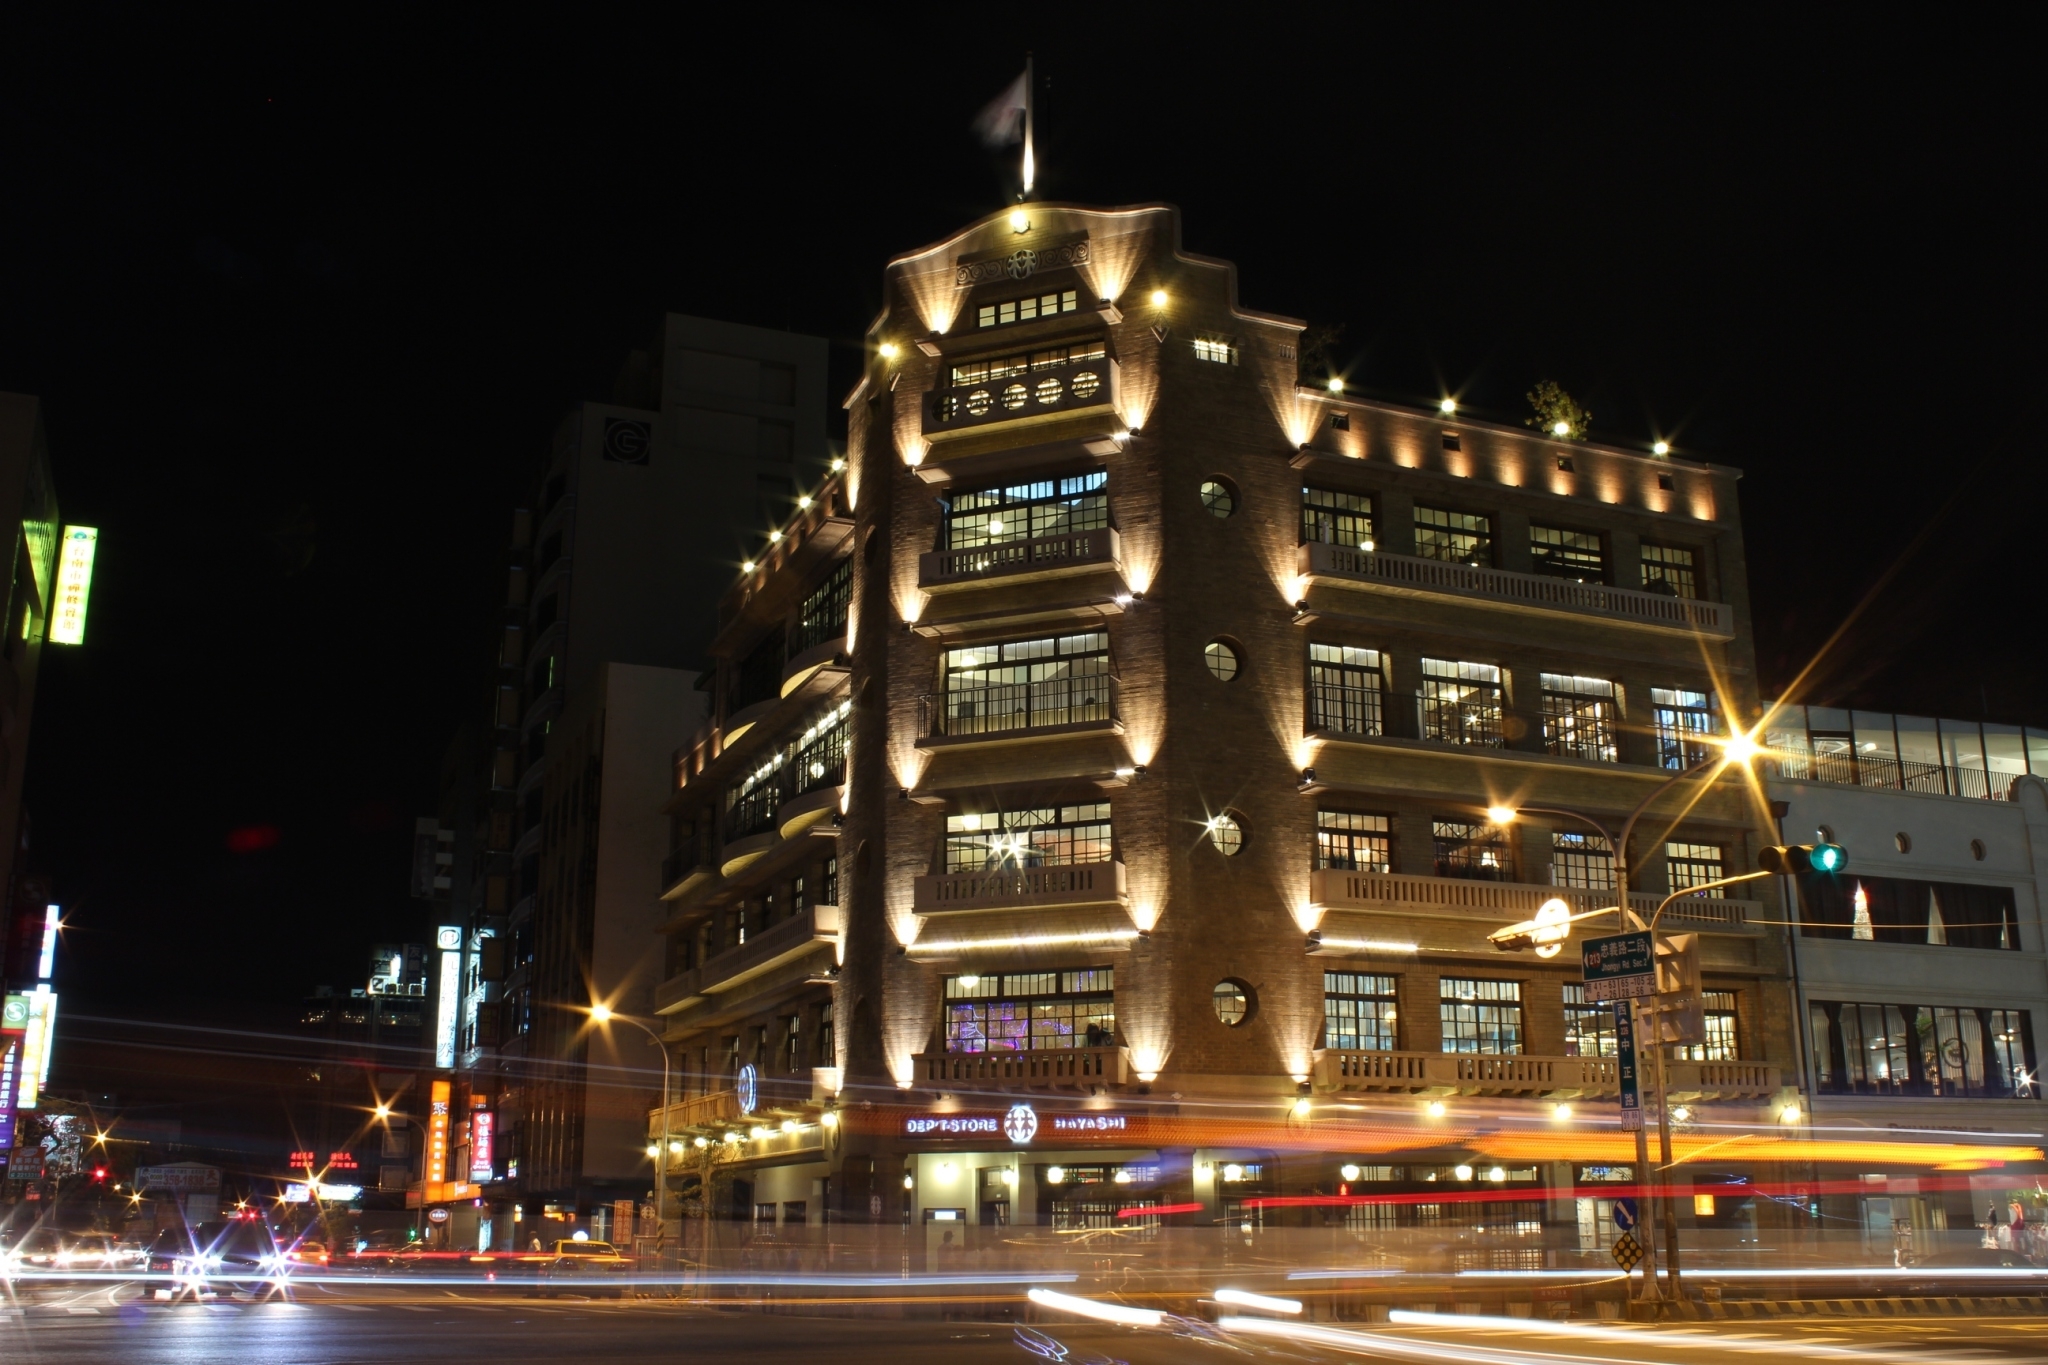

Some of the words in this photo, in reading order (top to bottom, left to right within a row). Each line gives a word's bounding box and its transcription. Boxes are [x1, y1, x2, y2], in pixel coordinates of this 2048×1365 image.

[1588, 952, 1601, 966] 213
[1600, 938, 1646, 958] 忠義路二段
[1622, 961, 1631, 969] Rd.
[1616, 1002, 1627, 1016] 西
[1621, 1038, 1634, 1107] 中正路
[1055, 1116, 1126, 1131] HAYASHI
